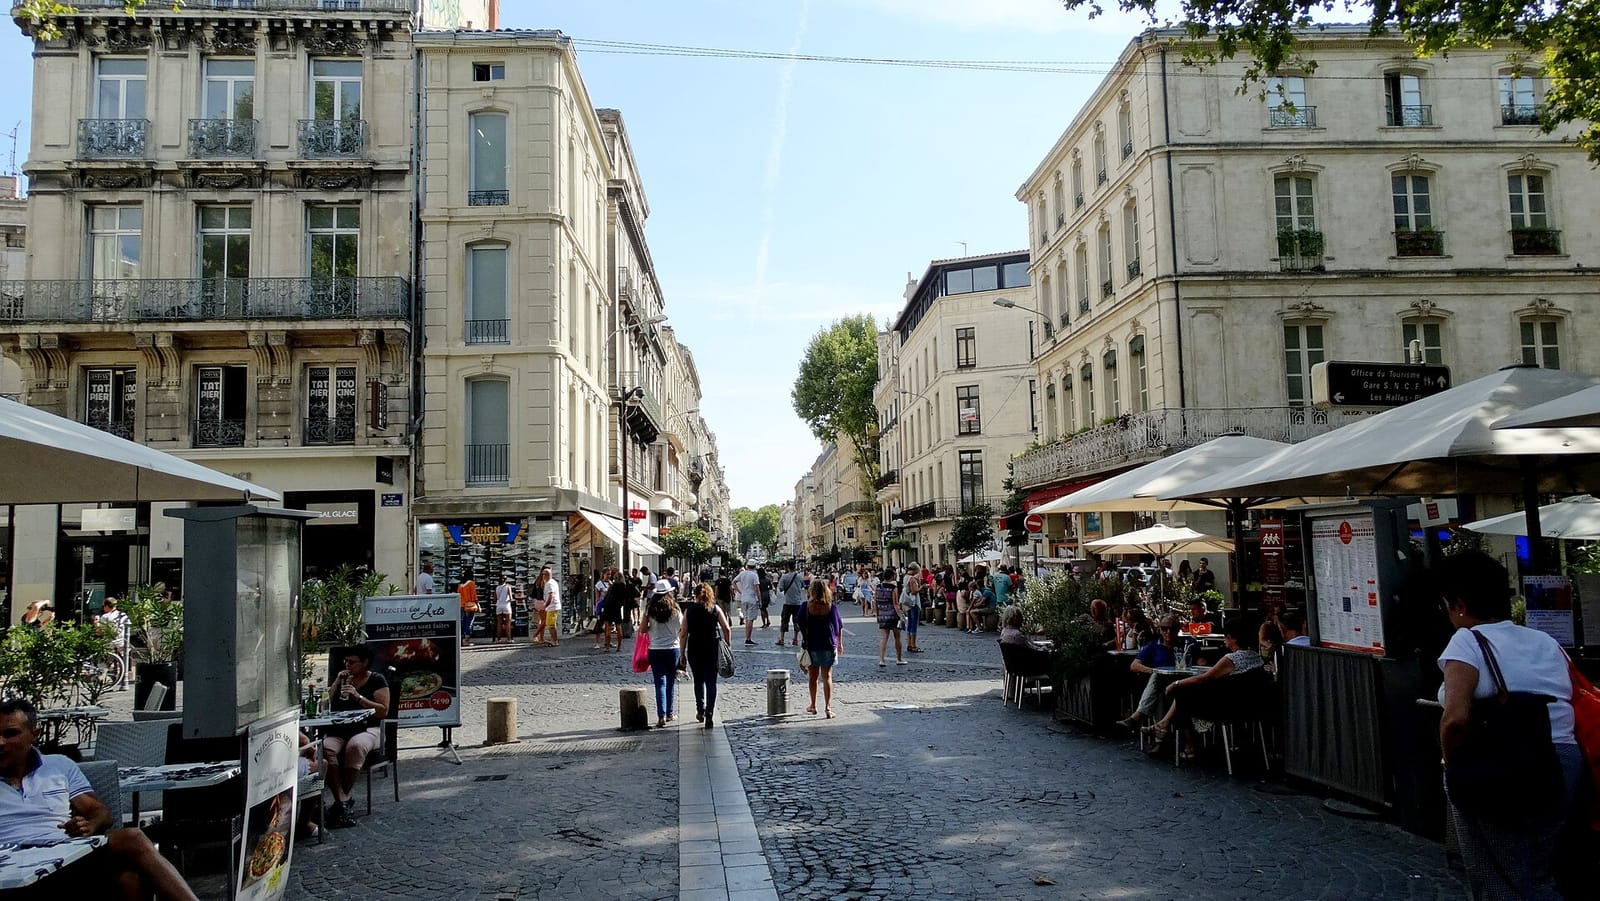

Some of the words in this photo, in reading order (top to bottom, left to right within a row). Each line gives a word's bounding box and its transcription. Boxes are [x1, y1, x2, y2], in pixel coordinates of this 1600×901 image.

[1350, 369, 1373, 377] Office
[1376, 369, 1386, 378] du
[1388, 370, 1421, 379] Tourisme
[91, 384, 110, 393] TAT
[202, 381, 220, 390] TAT
[311, 380, 328, 389] TAT
[336, 380, 355, 388] TOO
[1362, 381, 1381, 390] Gare
[90, 393, 110, 401] PIER
[201, 390, 220, 399] PIER
[310, 389, 328, 397] PIER
[336, 388, 355, 396] CING
[1370, 393, 1382, 401] Les
[332, 510, 357, 518] GLACE
[468, 525, 501, 535] CANON
[375, 606, 407, 615] Pizzeria
[411, 603, 446, 620] Arts
